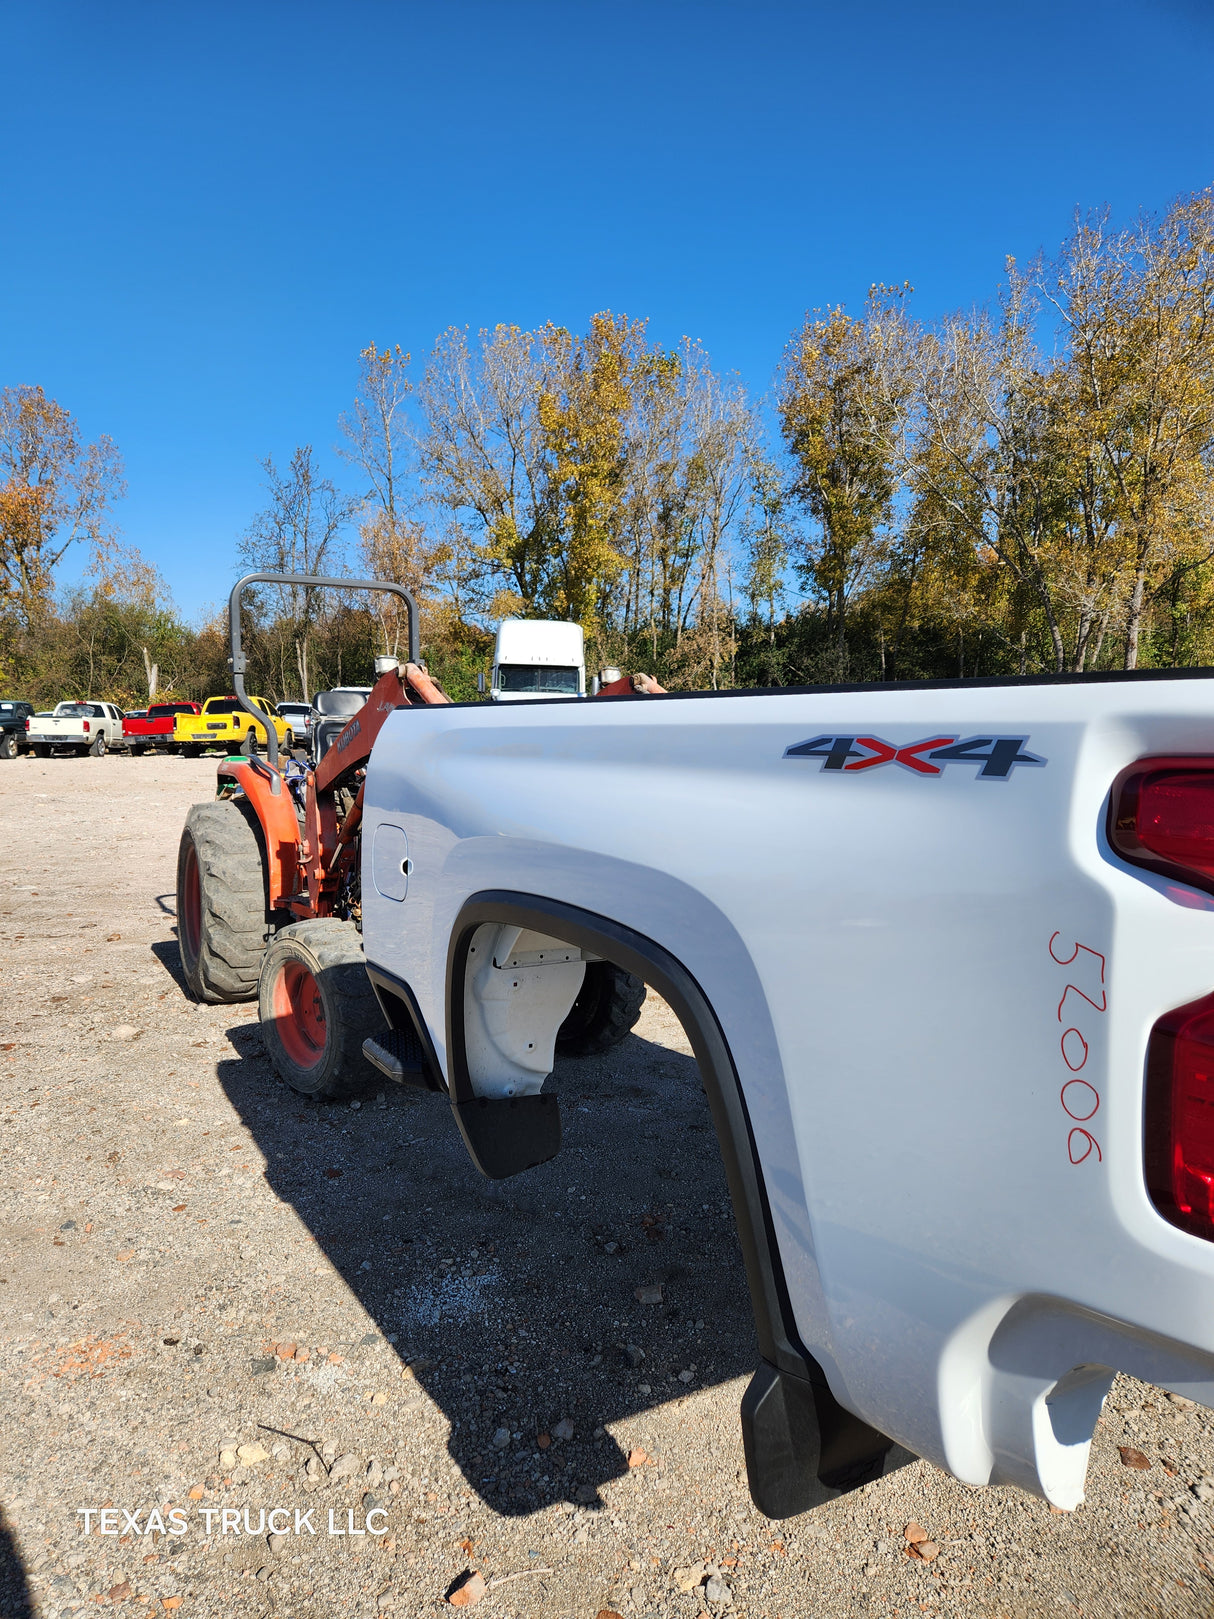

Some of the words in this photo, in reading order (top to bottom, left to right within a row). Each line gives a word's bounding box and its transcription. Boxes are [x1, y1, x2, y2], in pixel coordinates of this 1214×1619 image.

[337, 718, 362, 754] KUBOTA
[783, 734, 1047, 780] 4X4
[1049, 931, 1107, 1164] 52006
